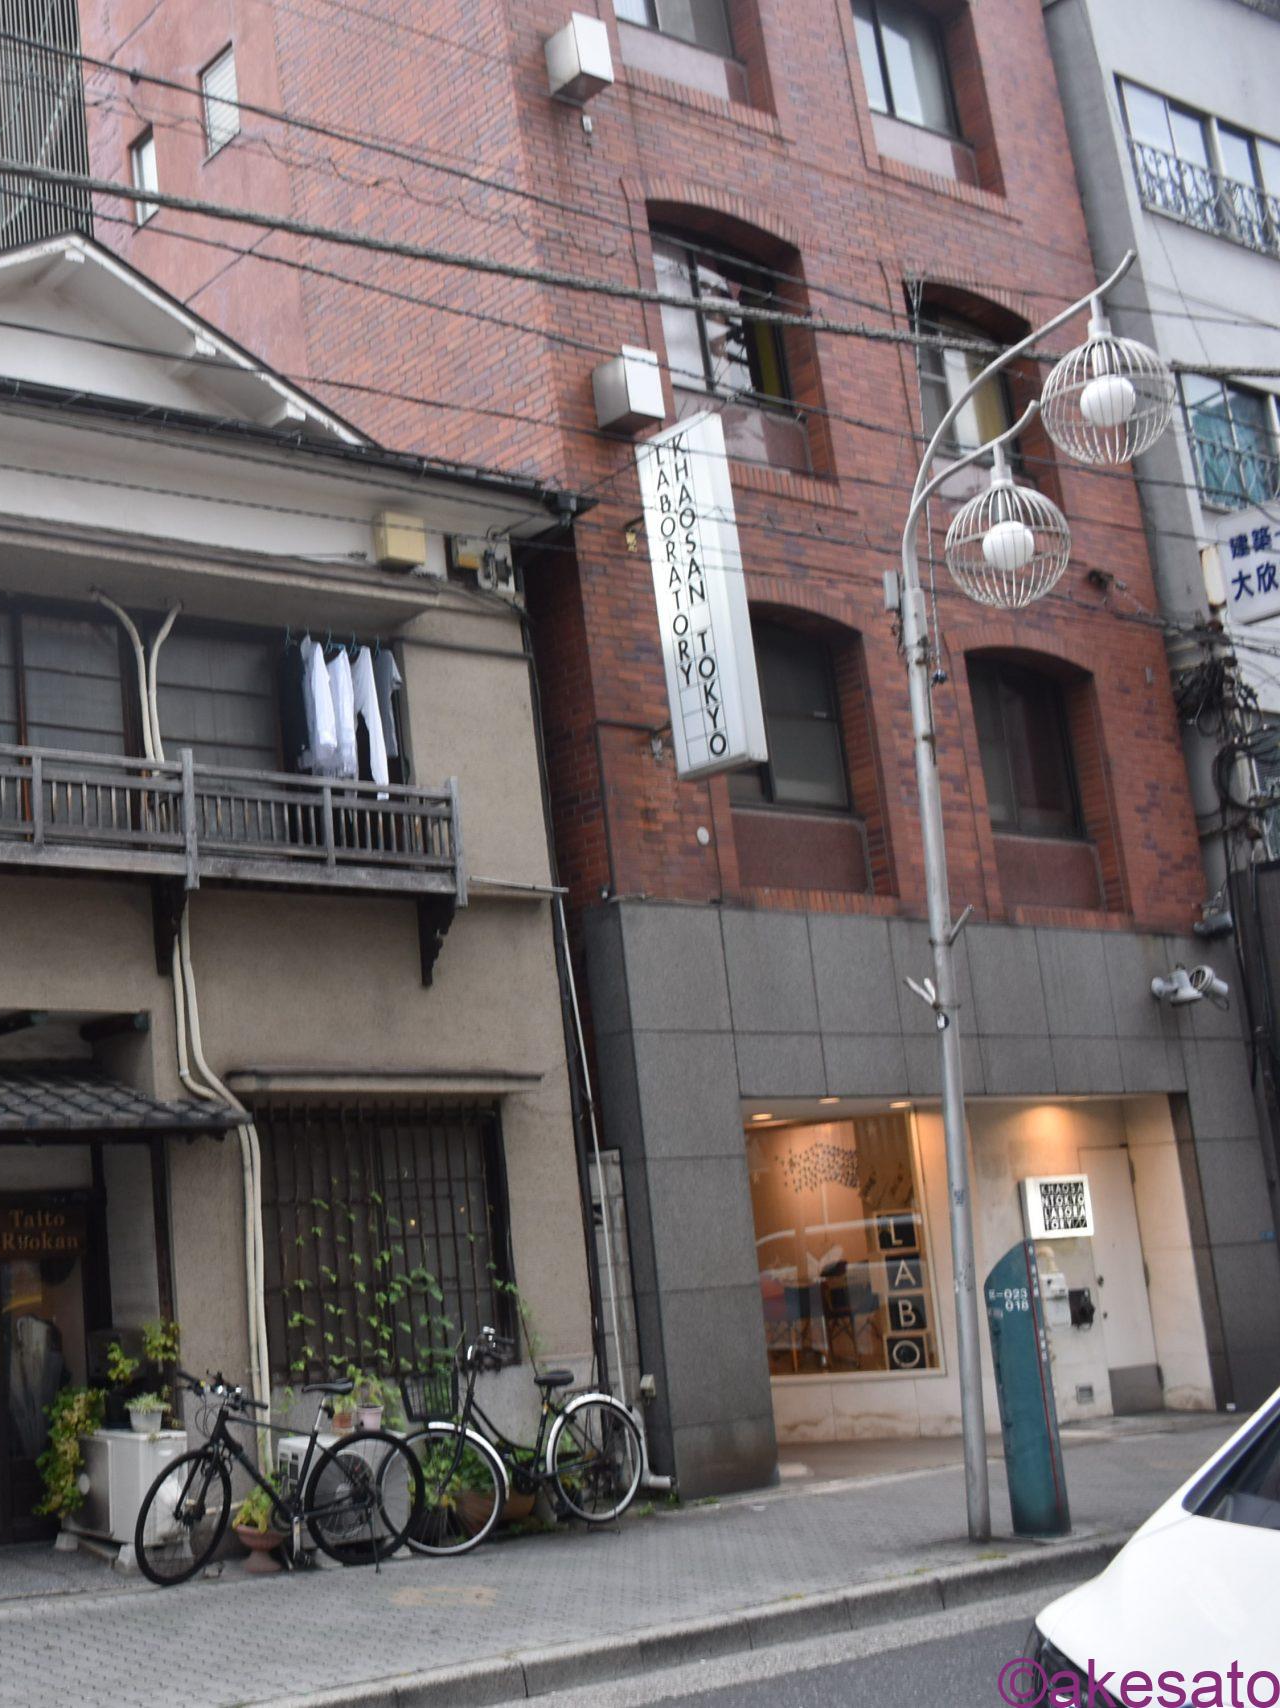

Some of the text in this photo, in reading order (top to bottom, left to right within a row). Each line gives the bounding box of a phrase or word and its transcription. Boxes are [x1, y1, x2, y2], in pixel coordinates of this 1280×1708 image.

[655, 445, 691, 687] LABORATORY
[672, 432, 727, 756] KHAOSAN TOKYO
[1, 1232, 80, 1251] Ryokan
[890, 1219, 920, 1368] LABO
